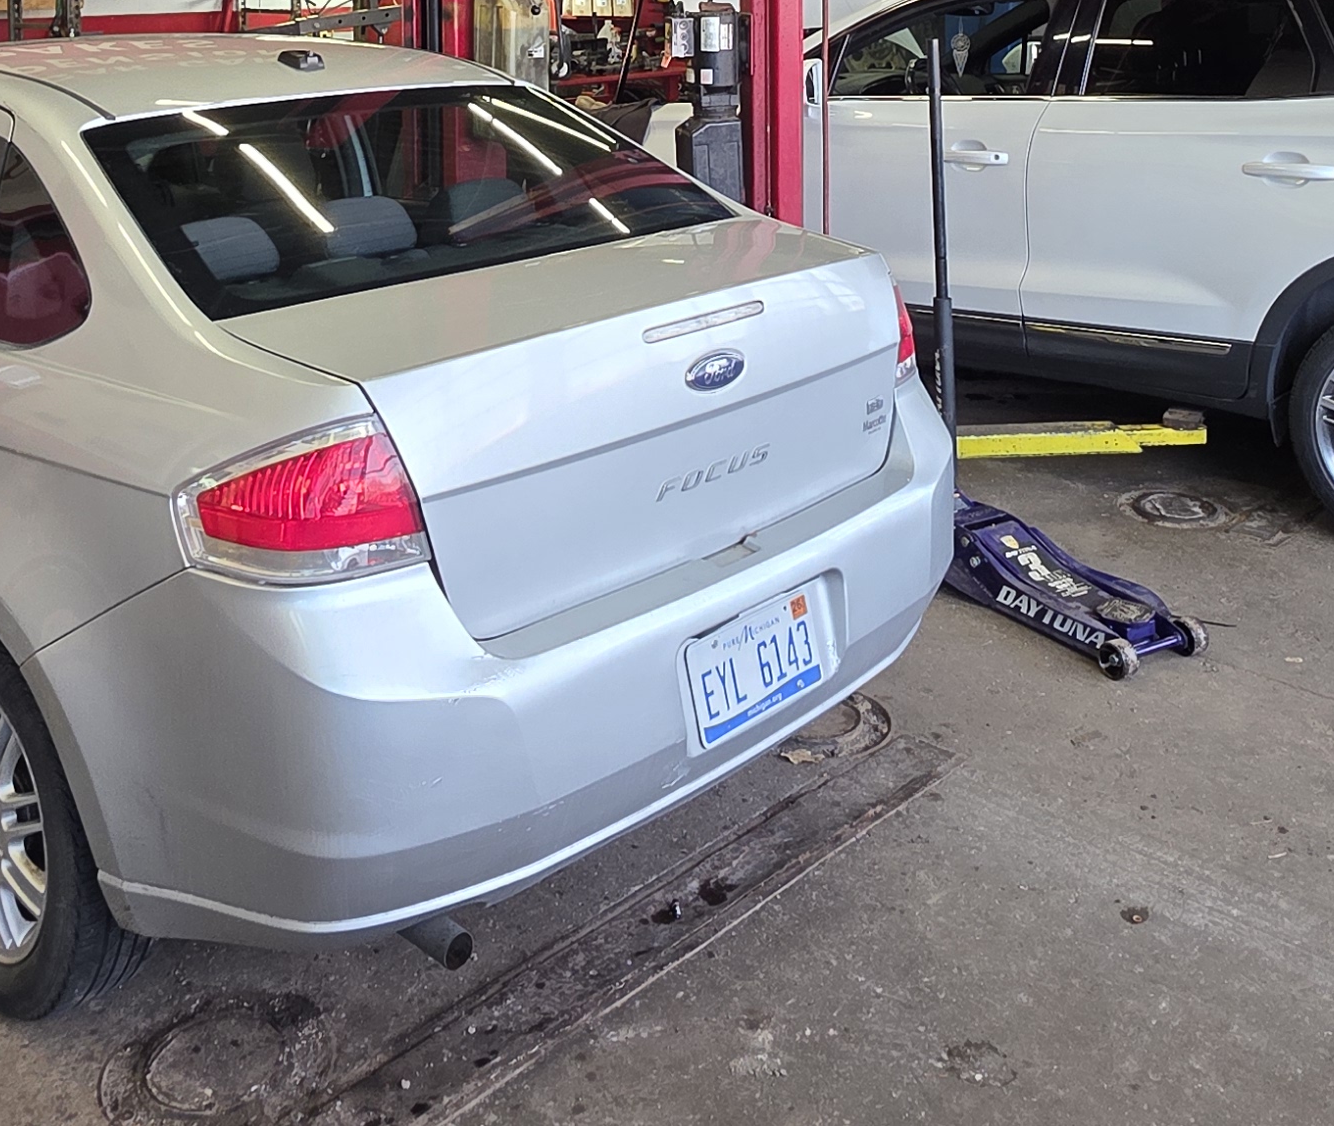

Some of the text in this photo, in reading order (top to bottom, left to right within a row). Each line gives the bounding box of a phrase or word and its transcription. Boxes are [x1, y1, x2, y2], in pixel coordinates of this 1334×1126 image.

[704, 358, 737, 385] Ford
[656, 443, 771, 503] FOCUS
[722, 616, 781, 651] PURE MICHIGAN
[995, 585, 1106, 650] DAYTONA
[701, 620, 813, 721] EYL 6143
[747, 692, 783, 718] michigan.org
